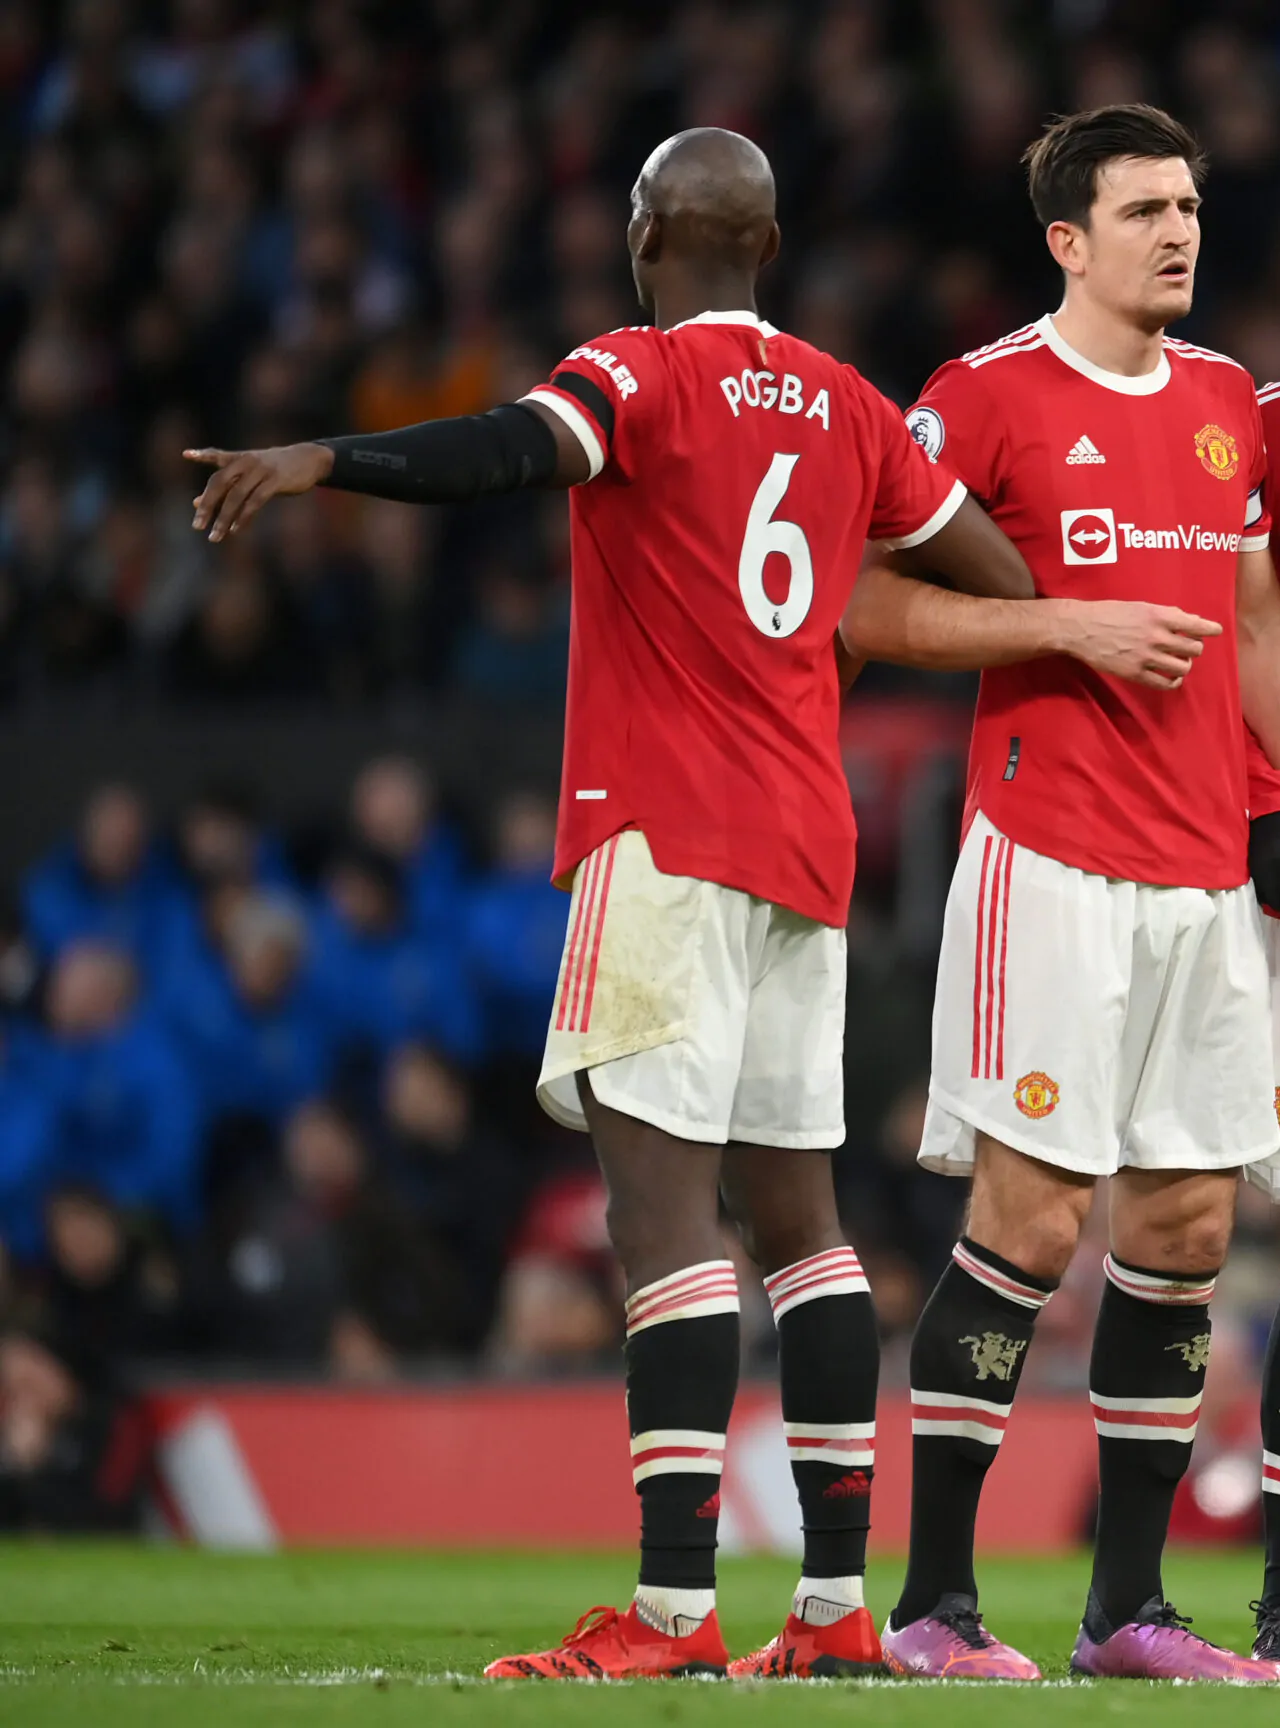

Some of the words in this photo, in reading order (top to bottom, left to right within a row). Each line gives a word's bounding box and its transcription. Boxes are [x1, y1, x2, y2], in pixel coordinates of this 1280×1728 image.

[720, 368, 829, 431] POGBA
[1066, 451, 1106, 465] adidas
[738, 451, 814, 638] 6
[1117, 523, 1242, 553] TeamViewer
